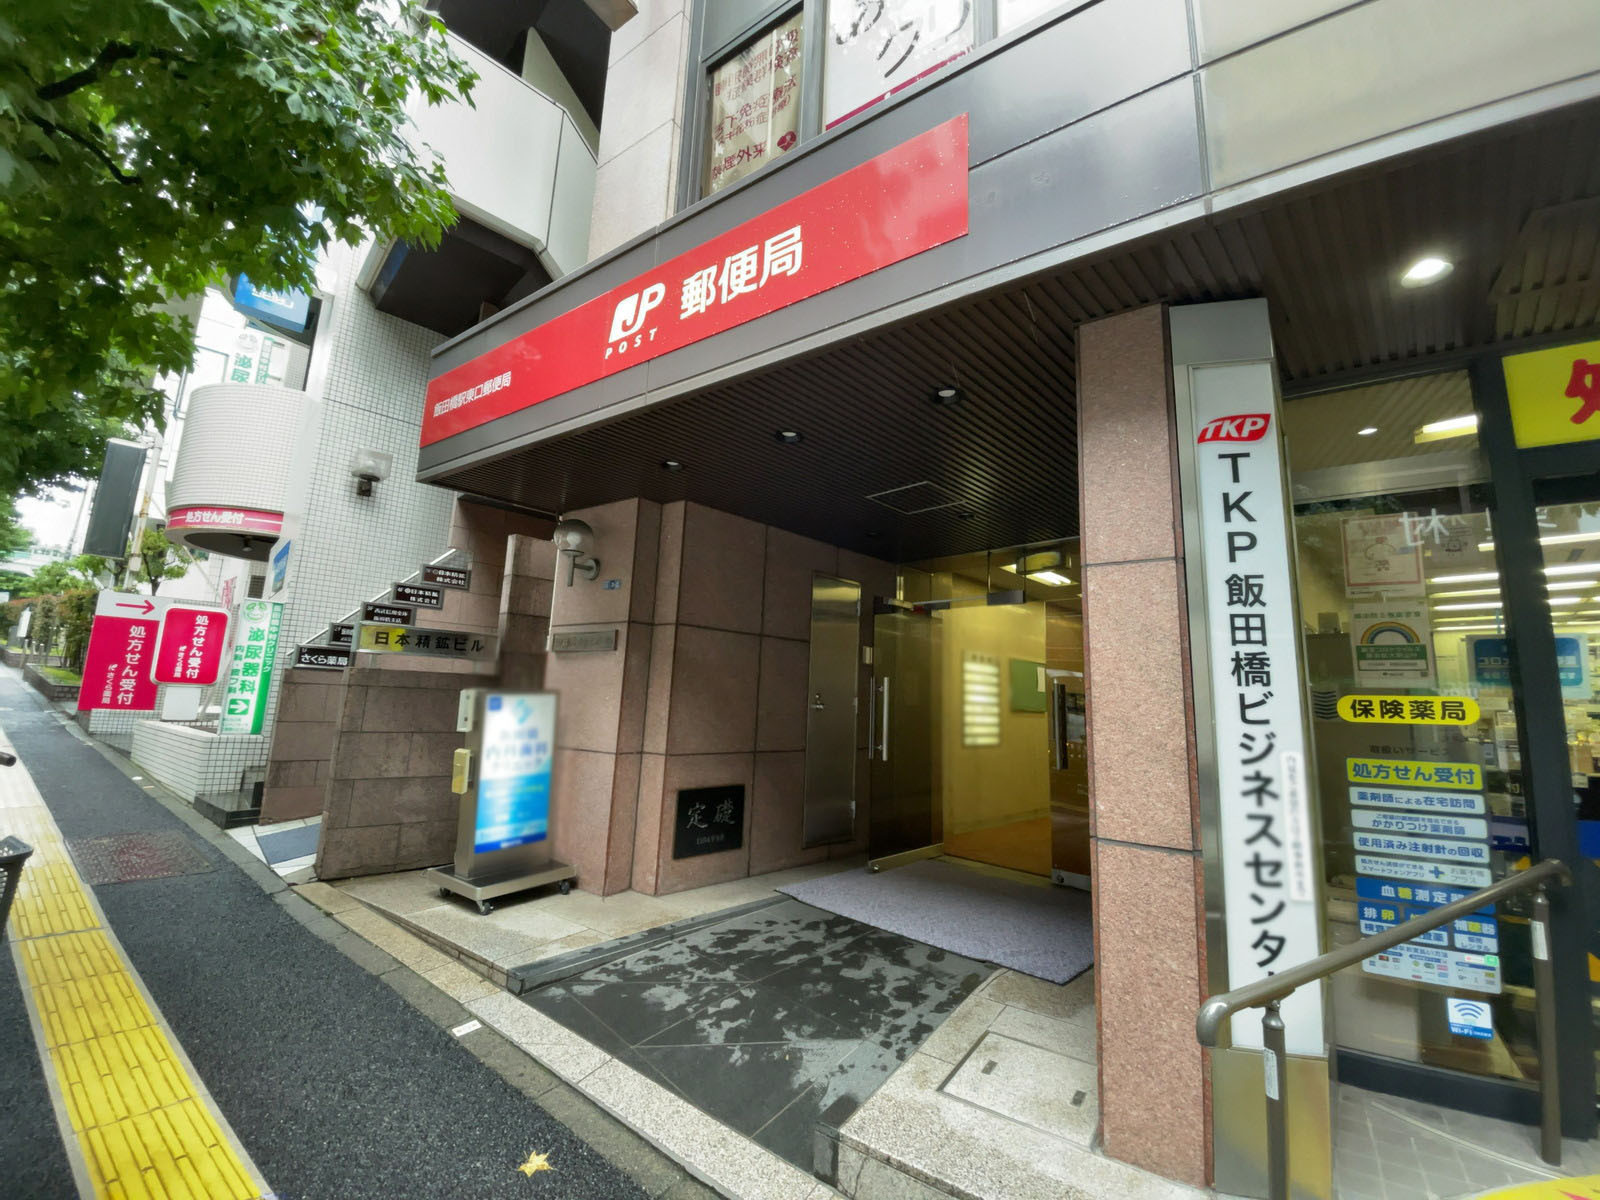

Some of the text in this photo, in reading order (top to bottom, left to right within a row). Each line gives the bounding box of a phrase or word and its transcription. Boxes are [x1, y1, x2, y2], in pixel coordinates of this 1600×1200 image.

[680, 225, 803, 320] 郵便局
[604, 327, 658, 360] POST
[432, 370, 512, 418] 飯田橋駅東口郵便局
[1202, 415, 1267, 441] TKP
[185, 511, 245, 525] 処方せん受付
[185, 614, 209, 679] 処方せん受付
[374, 631, 485, 653] 日本精鉱ビル
[116, 625, 147, 705] 処方せん受付
[238, 626, 265, 695] 泌尿器科
[301, 653, 348, 666] さくら薬局
[1217, 451, 1287, 977] TKP飯田橋ビジネスセンタ
[1350, 699, 1467, 721] 保険薬局
[1352, 763, 1475, 785] 処方せん受付
[1357, 791, 1476, 809] 薬剤師による在宅訪問
[686, 798, 737, 829] 定礎
[1372, 819, 1466, 836] かかりつけ薬剤師
[1358, 836, 1484, 858] 使用済み注射針の回収
[1363, 906, 1396, 921] 排卵
